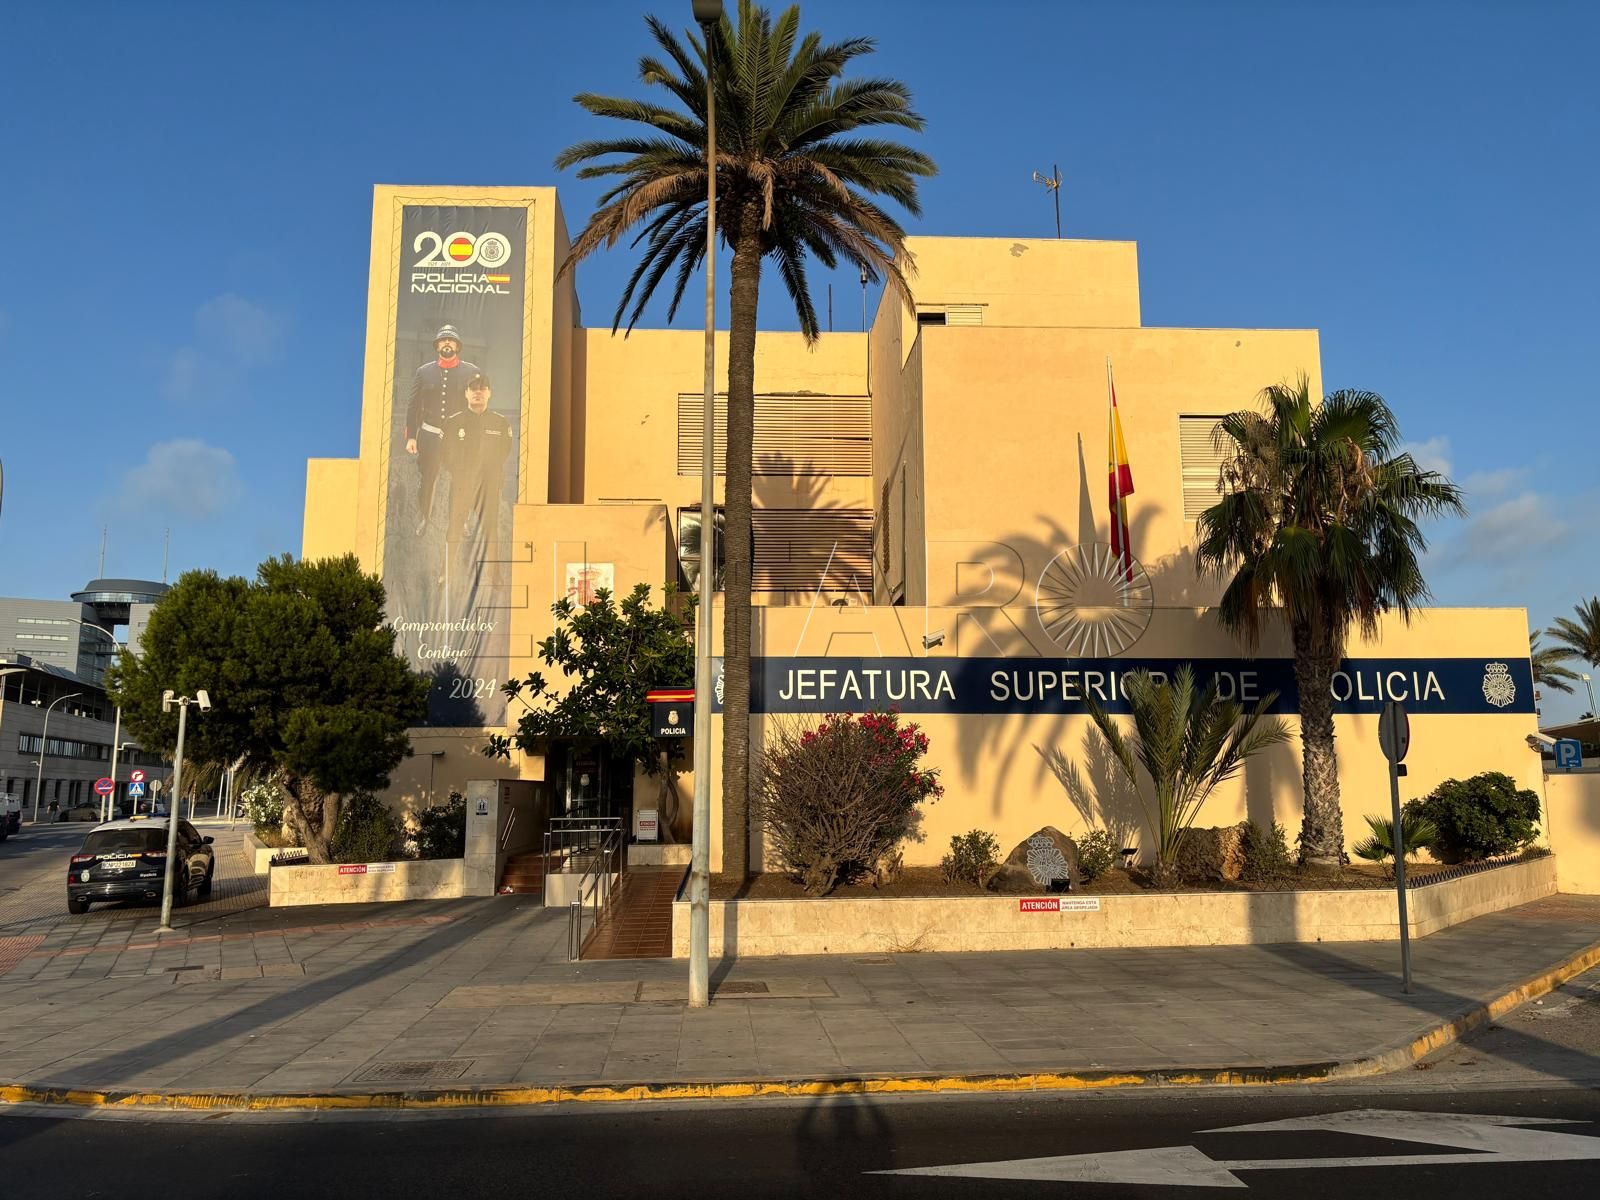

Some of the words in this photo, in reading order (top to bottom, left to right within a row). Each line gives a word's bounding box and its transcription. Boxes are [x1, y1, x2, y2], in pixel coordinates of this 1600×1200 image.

[413, 231, 512, 268] 200
[411, 273, 490, 283] POLICIA
[411, 283, 510, 294] NACIONAL
[393, 615, 498, 644] Comprometidos
[417, 643, 472, 666] Contigo
[449, 678, 497, 699] 2024
[779, 669, 956, 700] JEFATURA
[1214, 671, 1260, 701] DE
[1330, 671, 1445, 702] OLICIA
[660, 727, 686, 735] POLICIA
[1559, 743, 1576, 765] P
[1022, 900, 1058, 910] ATENCIÓN
